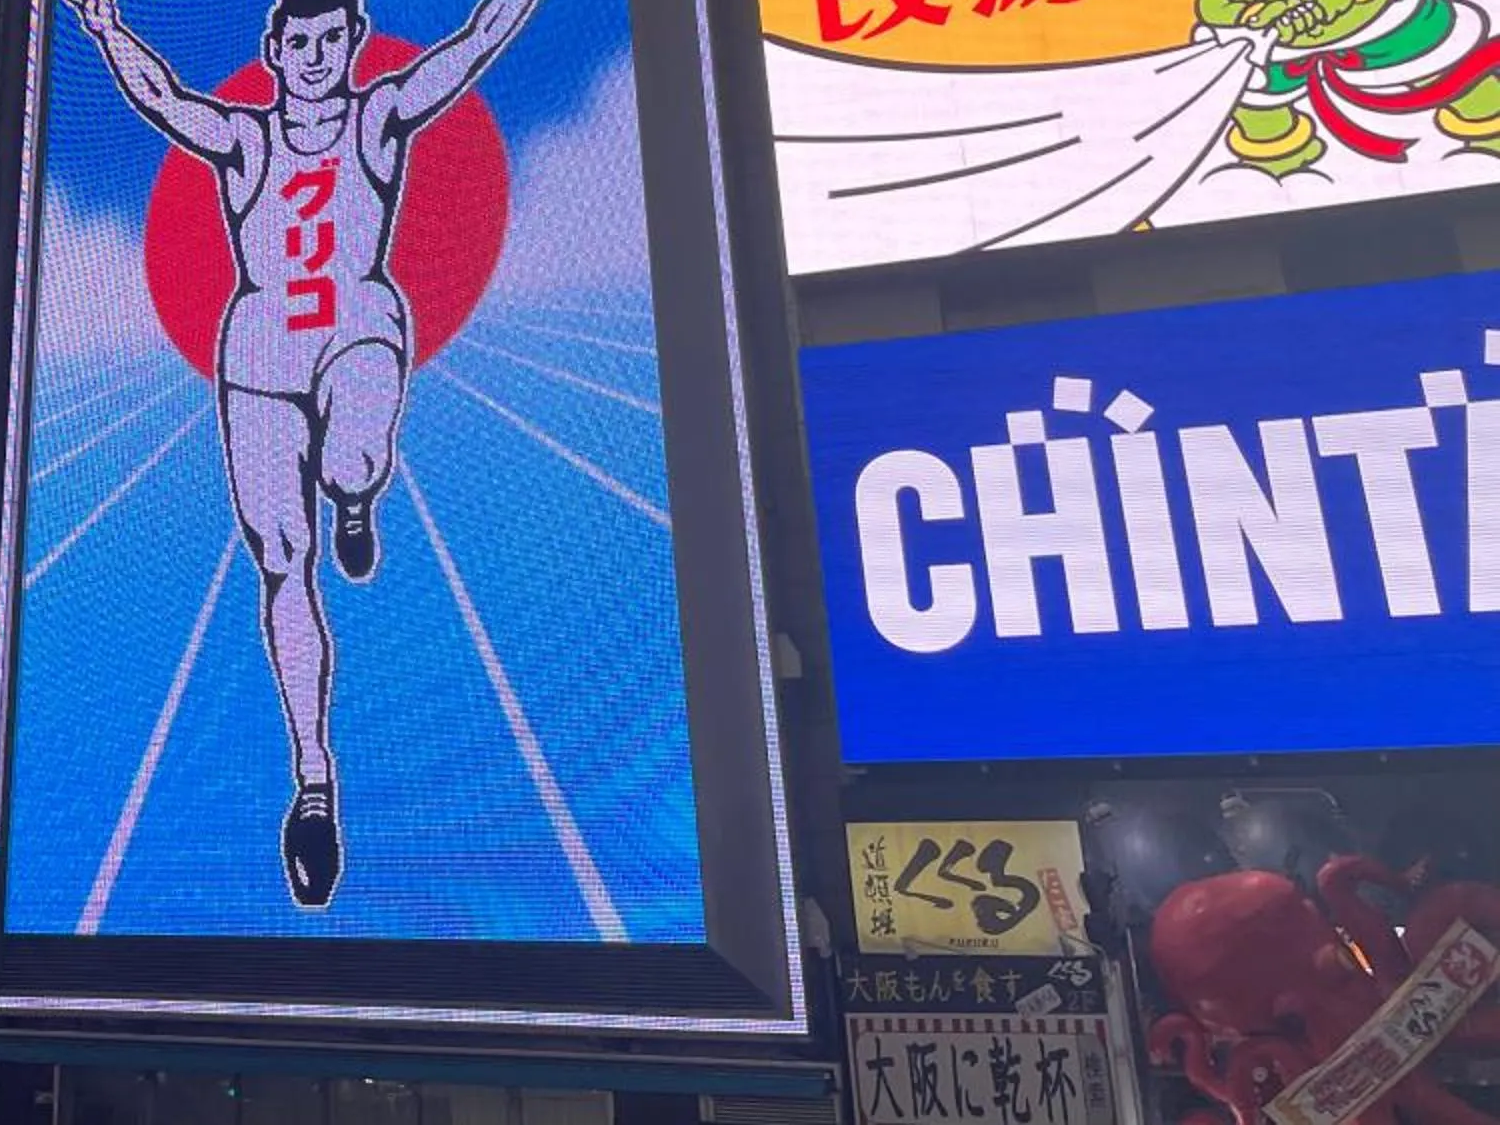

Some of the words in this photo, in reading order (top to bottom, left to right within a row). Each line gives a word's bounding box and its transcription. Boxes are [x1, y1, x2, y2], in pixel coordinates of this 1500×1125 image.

[280, 156, 341, 332] グリコ
[893, 838, 1042, 936] くくる
[865, 1035, 1078, 1125] 大阪に乾杯
